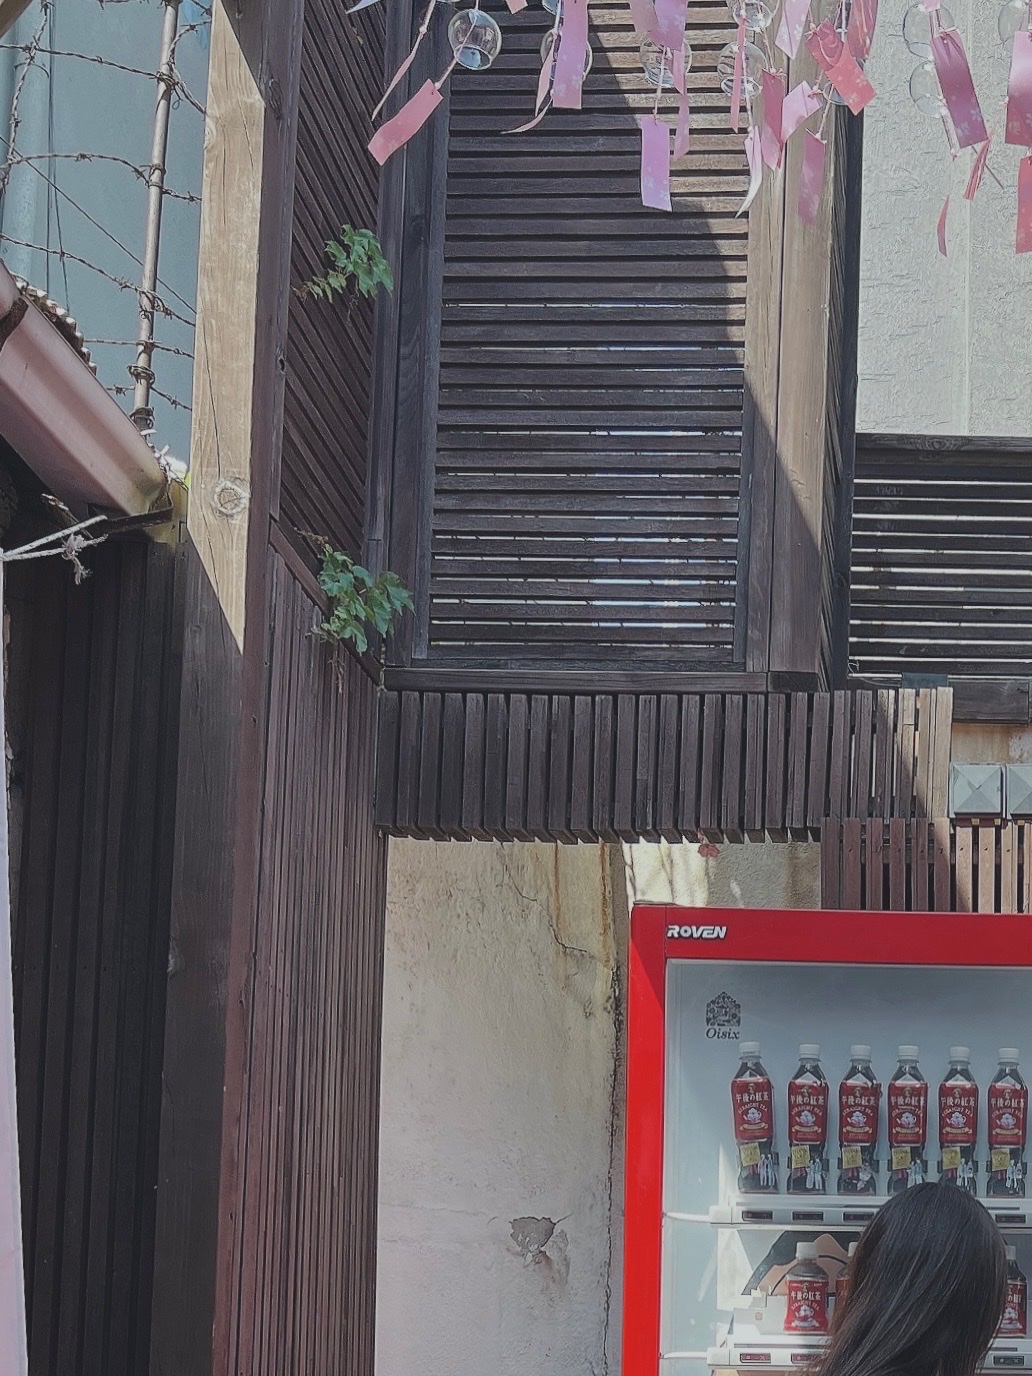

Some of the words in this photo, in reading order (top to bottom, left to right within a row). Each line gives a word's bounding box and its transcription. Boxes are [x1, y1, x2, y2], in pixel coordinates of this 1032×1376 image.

[667, 925, 727, 939] ROVEN
[706, 1028, 740, 1040] Oisix
[736, 1091, 769, 1103] 午後の紅茶
[841, 1095, 876, 1106] 午後の紅茶
[790, 1290, 822, 1301] 午後の紅茶
